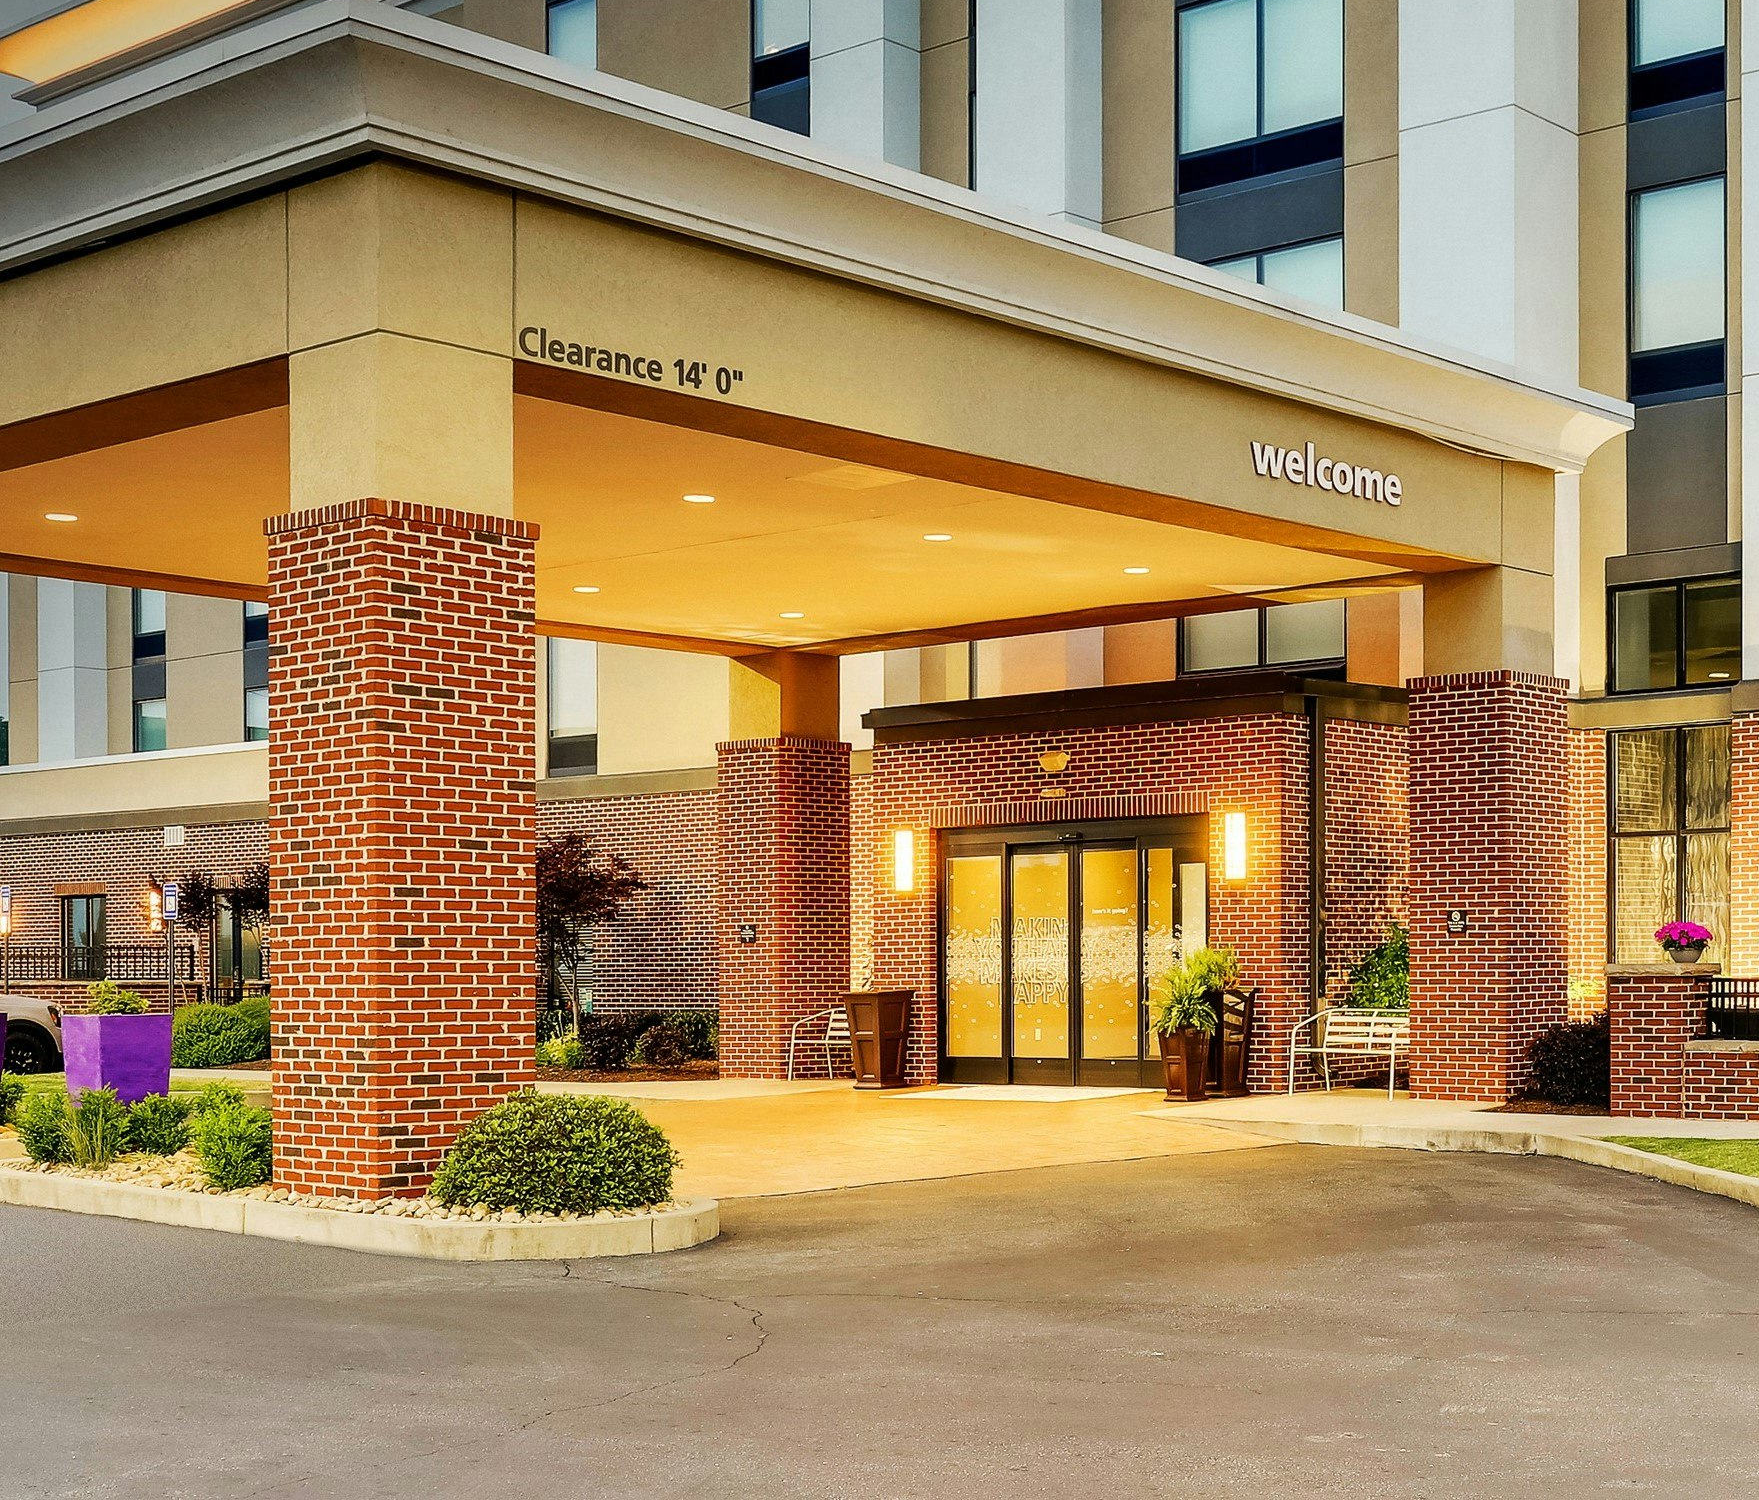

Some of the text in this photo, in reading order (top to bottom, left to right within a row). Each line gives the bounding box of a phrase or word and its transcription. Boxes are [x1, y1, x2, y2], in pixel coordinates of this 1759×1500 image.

[518, 326, 744, 395] Clearance 14' 0"
[1250, 440, 1403, 506] welcome
[990, 916, 1069, 940] MAKIN
[1026, 937, 1098, 961] HAPY
[998, 981, 1070, 1004] APPY
